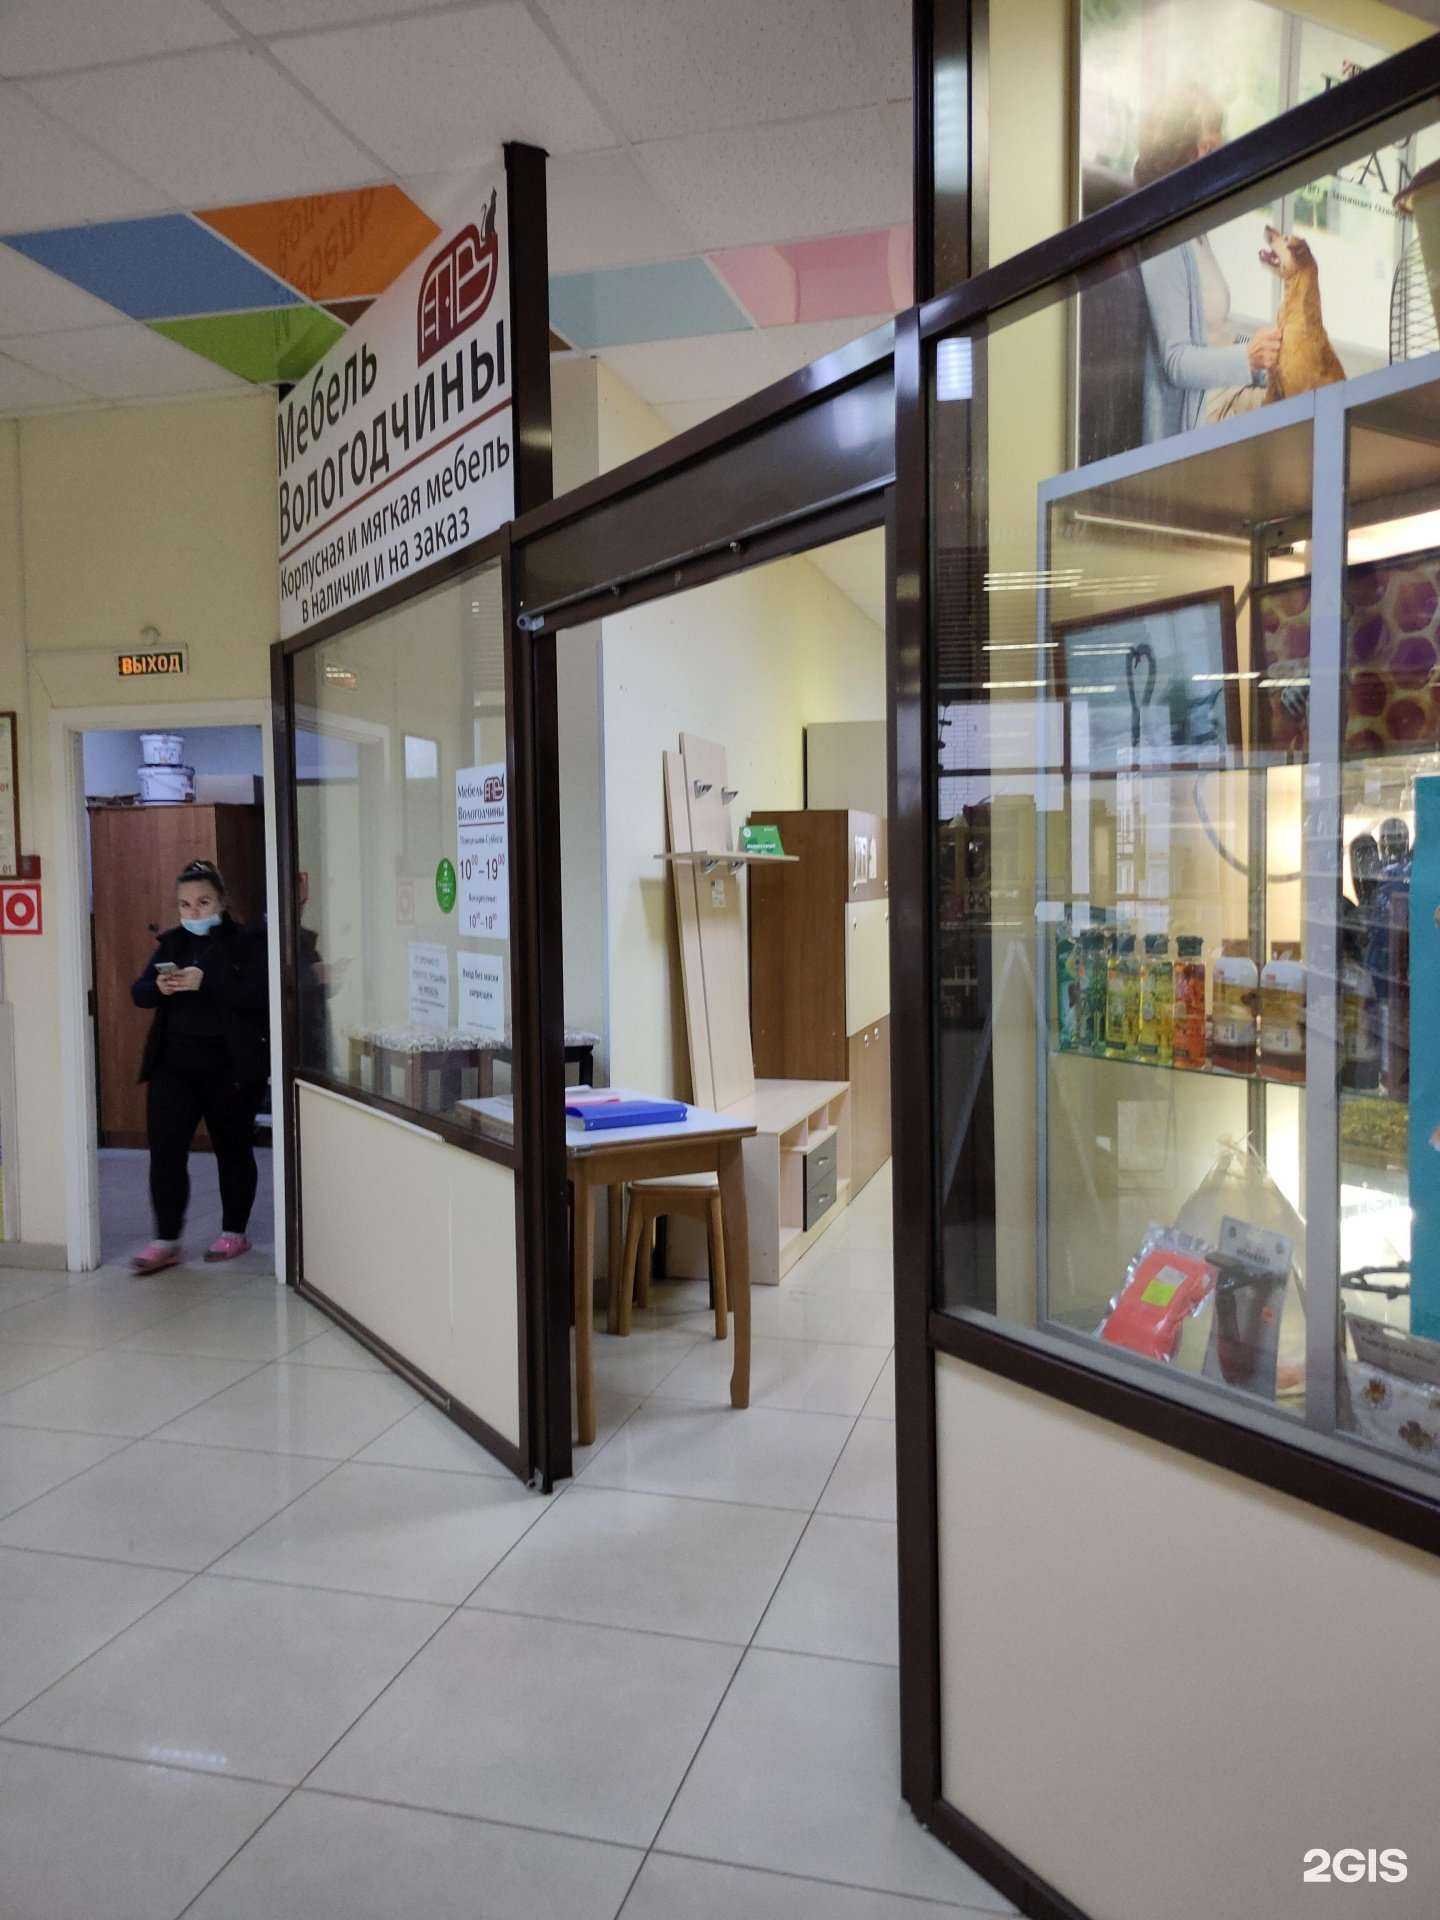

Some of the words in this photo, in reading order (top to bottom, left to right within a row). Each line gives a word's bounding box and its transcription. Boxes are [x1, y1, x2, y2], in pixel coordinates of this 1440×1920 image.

[278, 342, 378, 477] Мебель
[279, 319, 505, 546] Вологодчины
[281, 535, 345, 601] Корпусная
[348, 528, 358, 557] и
[361, 484, 422, 550] мягкая
[426, 436, 511, 510] мебель
[301, 599, 309, 624] в
[312, 560, 372, 618] наличии
[374, 552, 385, 585] и
[388, 539, 410, 576] на
[414, 506, 471, 562] заказ
[121, 654, 181, 674] ВЫХОД
[458, 785, 484, 799] Мебель
